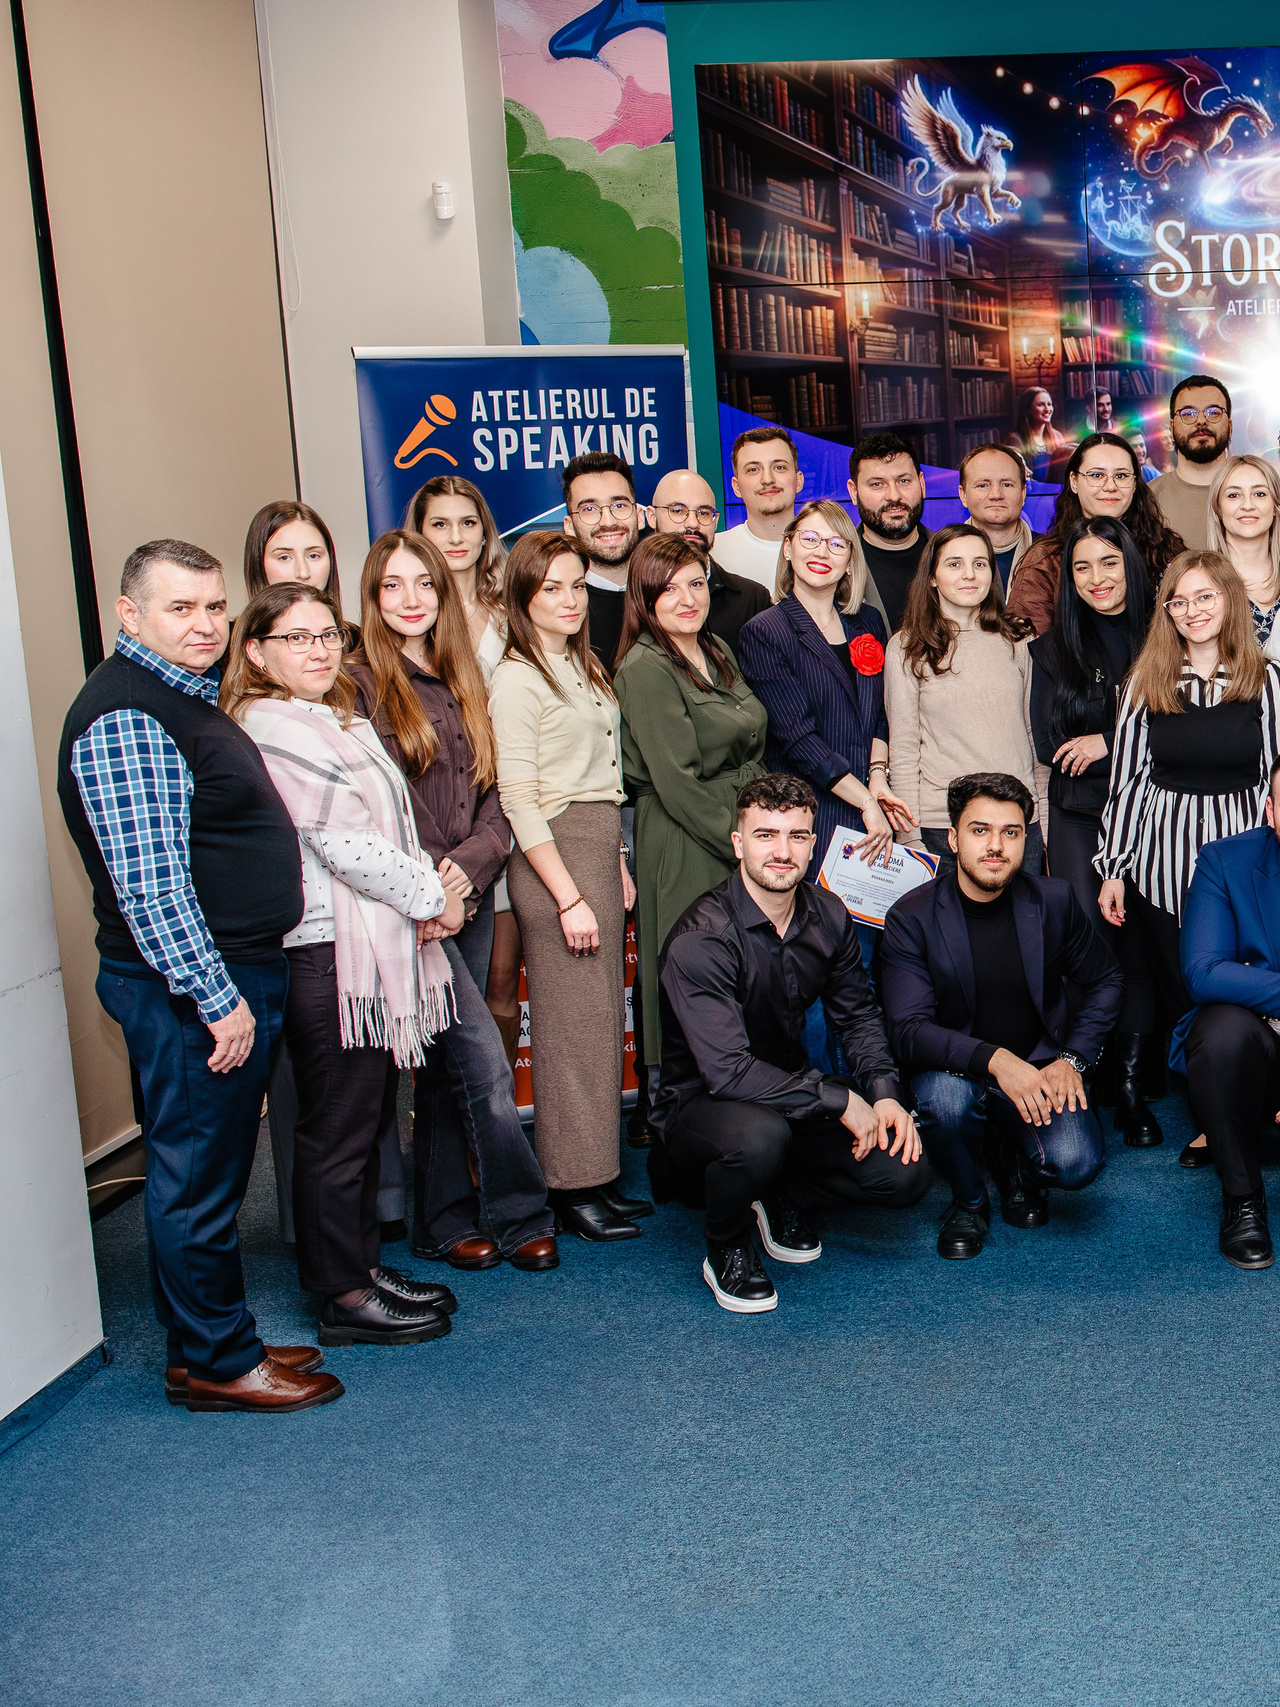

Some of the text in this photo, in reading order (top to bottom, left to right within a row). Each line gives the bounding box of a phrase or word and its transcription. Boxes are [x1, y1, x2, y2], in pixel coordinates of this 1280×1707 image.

[471, 387, 658, 422] ATELIERUL DE
[472, 423, 660, 472] SPEAKING
